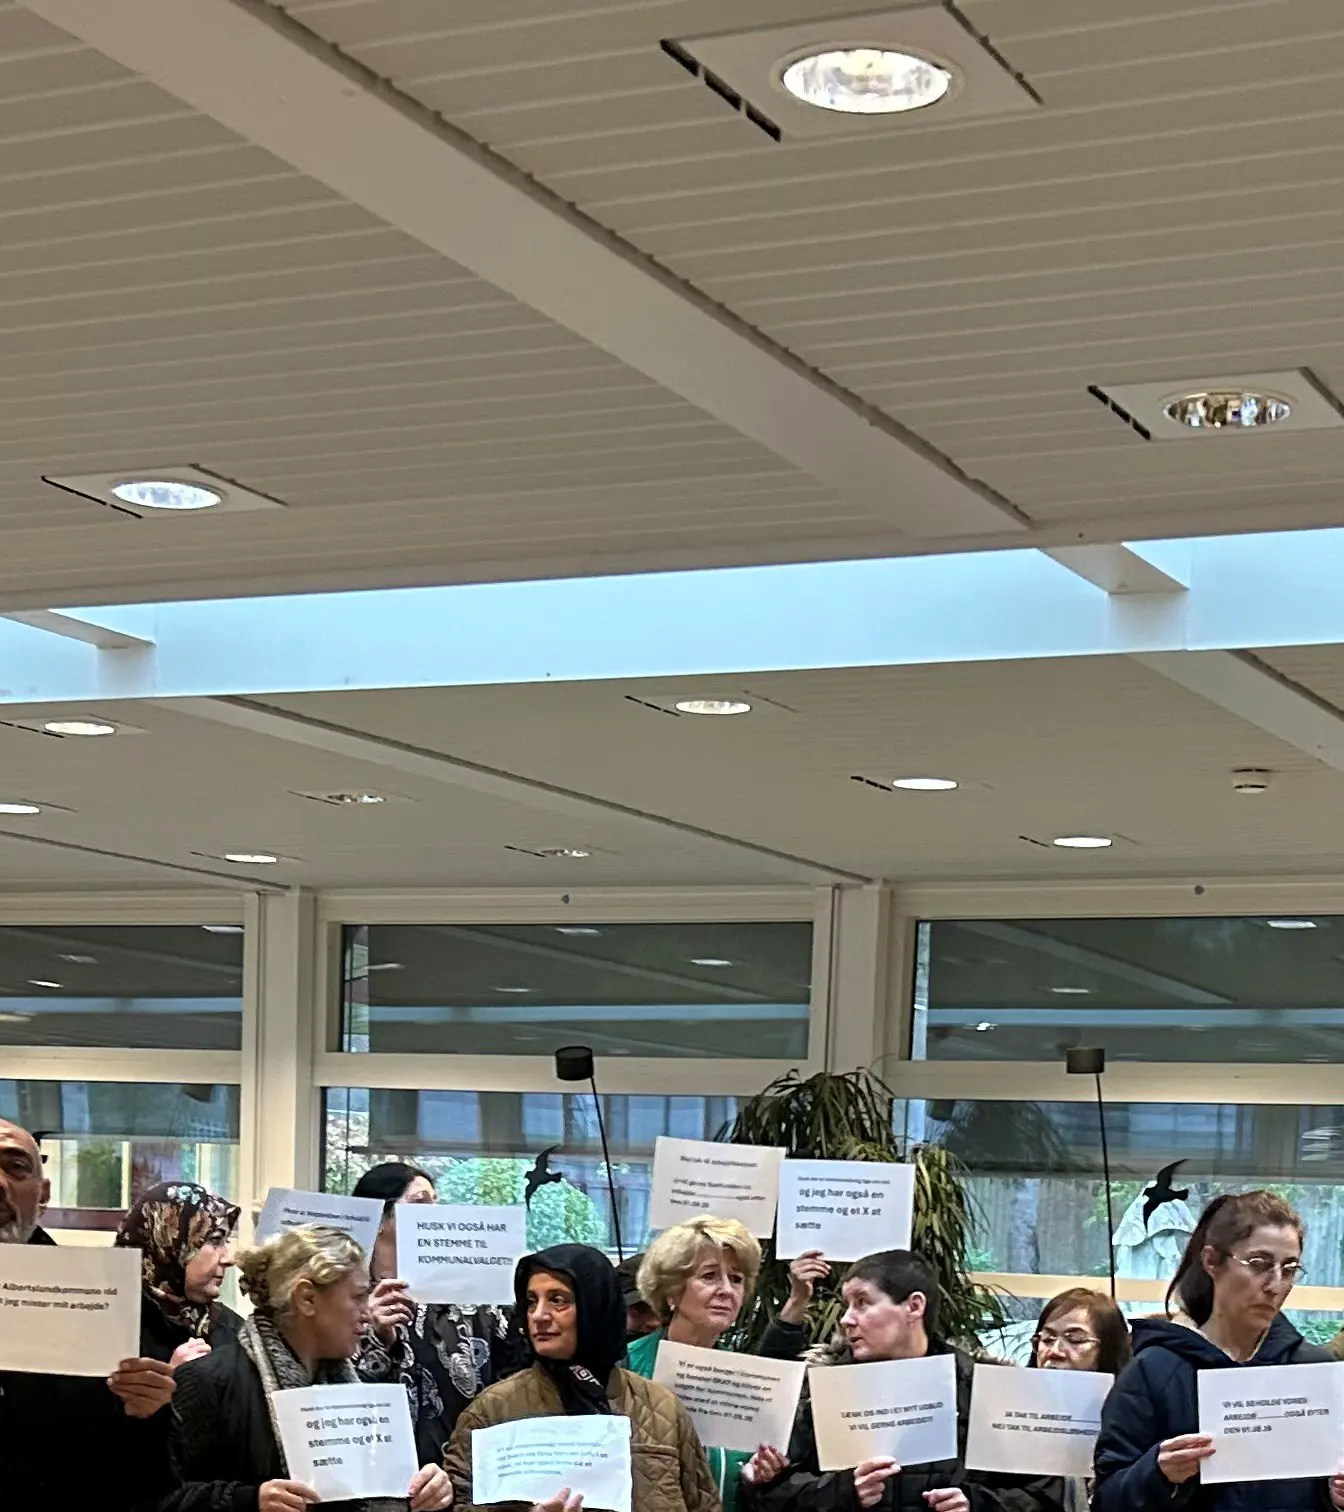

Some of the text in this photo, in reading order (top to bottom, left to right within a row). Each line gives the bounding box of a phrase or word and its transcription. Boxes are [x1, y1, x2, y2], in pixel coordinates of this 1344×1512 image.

[799, 1189, 810, 1197] og
[812, 1188, 826, 1198] jeg
[827, 1188, 843, 1196] har
[846, 1189, 868, 1199] også
[796, 1205, 834, 1213] stemme
[836, 1207, 848, 1216] og
[850, 1207, 860, 1215] et
[862, 1207, 870, 1215] X
[417, 1220, 507, 1232] HUSK VI OGSÅ HAR
[417, 1238, 488, 1249] EN STEMME TIL
[4, 1298, 19, 1307] jeg
[306, 1420, 320, 1430] og
[321, 1418, 338, 1429] jeg
[337, 1416, 354, 1425] har
[378, 1416, 390, 1424] en
[1006, 1423, 1020, 1431] TAK
[308, 1438, 350, 1448] stemme
[352, 1436, 365, 1445] og
[375, 1433, 383, 1443] X
